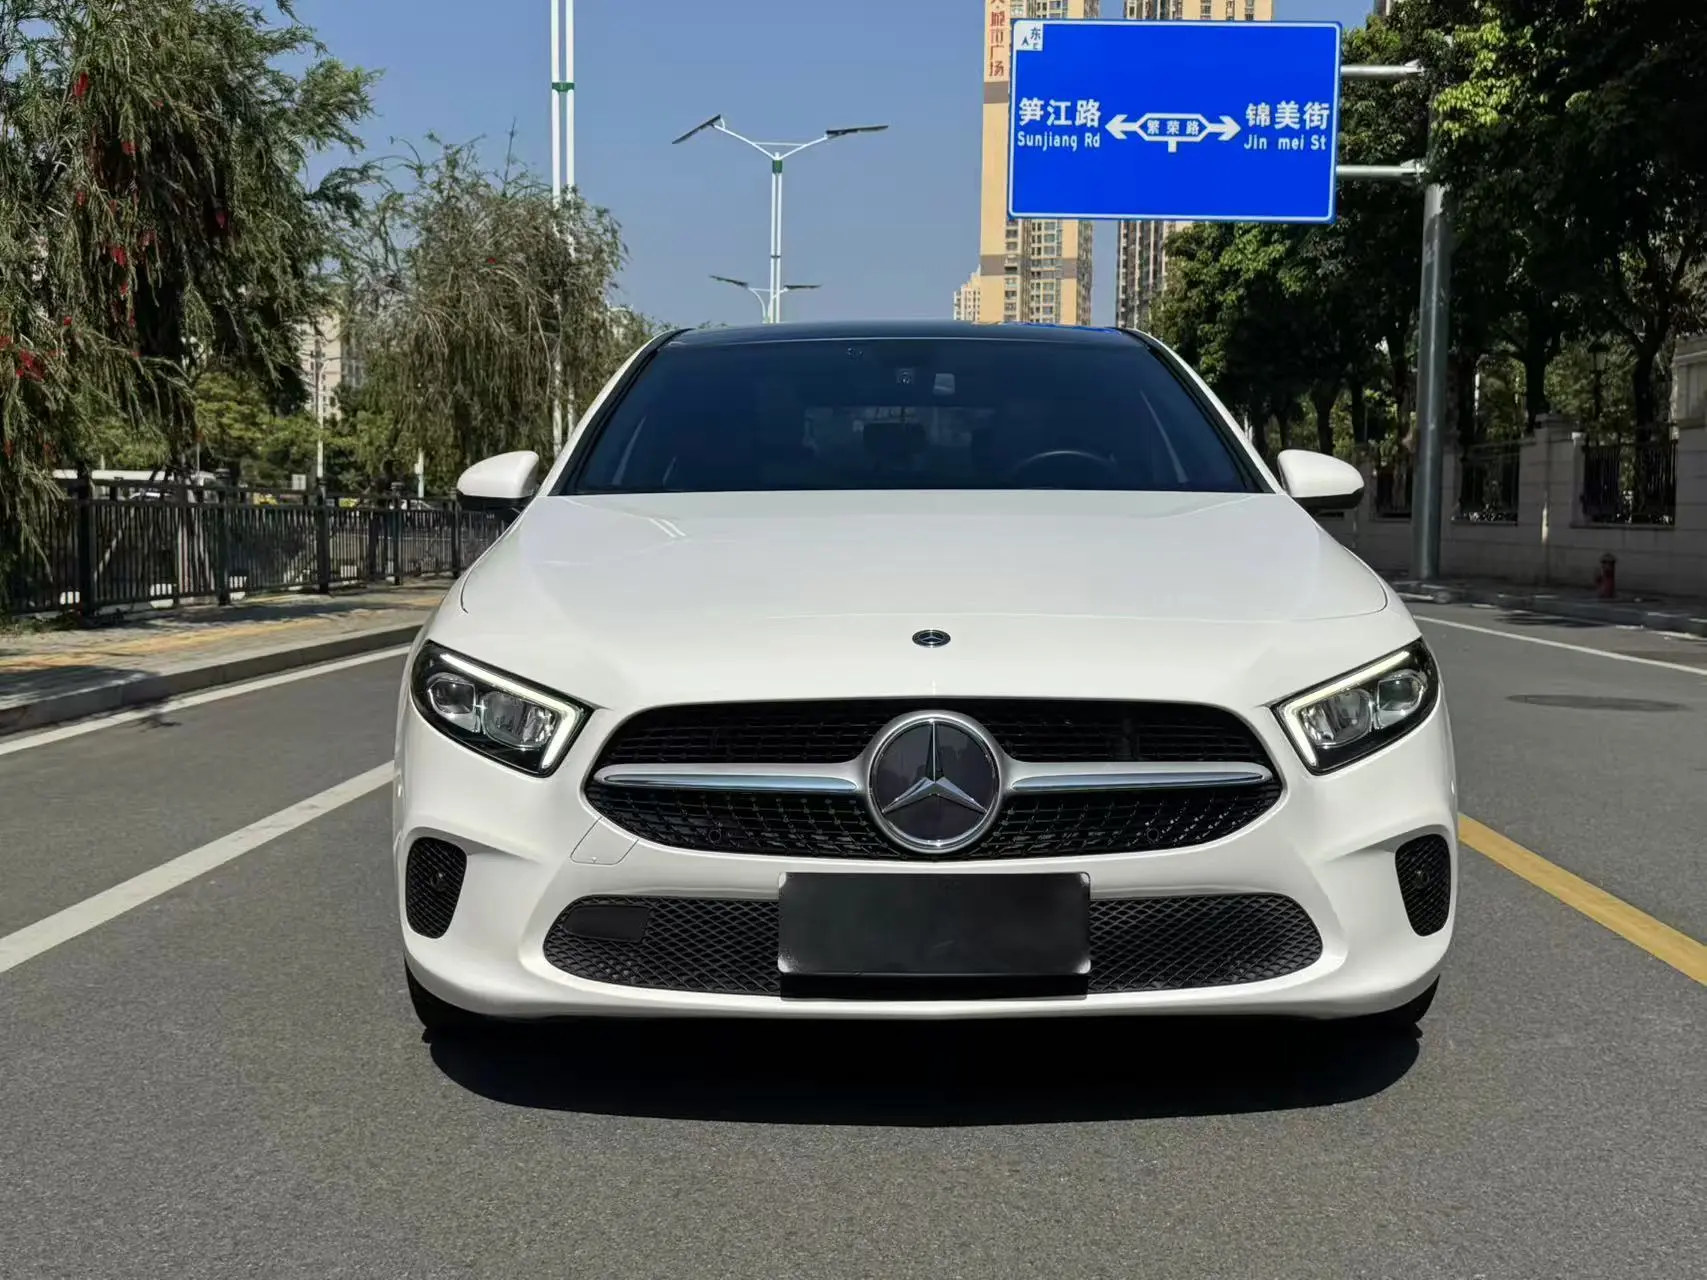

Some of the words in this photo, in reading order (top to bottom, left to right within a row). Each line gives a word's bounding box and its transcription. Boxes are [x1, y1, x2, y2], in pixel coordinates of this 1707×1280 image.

[1030, 27, 1041, 41] 东
[1018, 97, 1101, 128] 笋江路
[1245, 100, 1330, 130] 锦美街
[1146, 119, 1200, 135] 繁荣路
[1017, 130, 1077, 152] Sunjiang
[1084, 132, 1101, 148] Rd
[1243, 134, 1267, 150] Jin
[1278, 134, 1304, 150] mei
[1310, 134, 1327, 151] St
